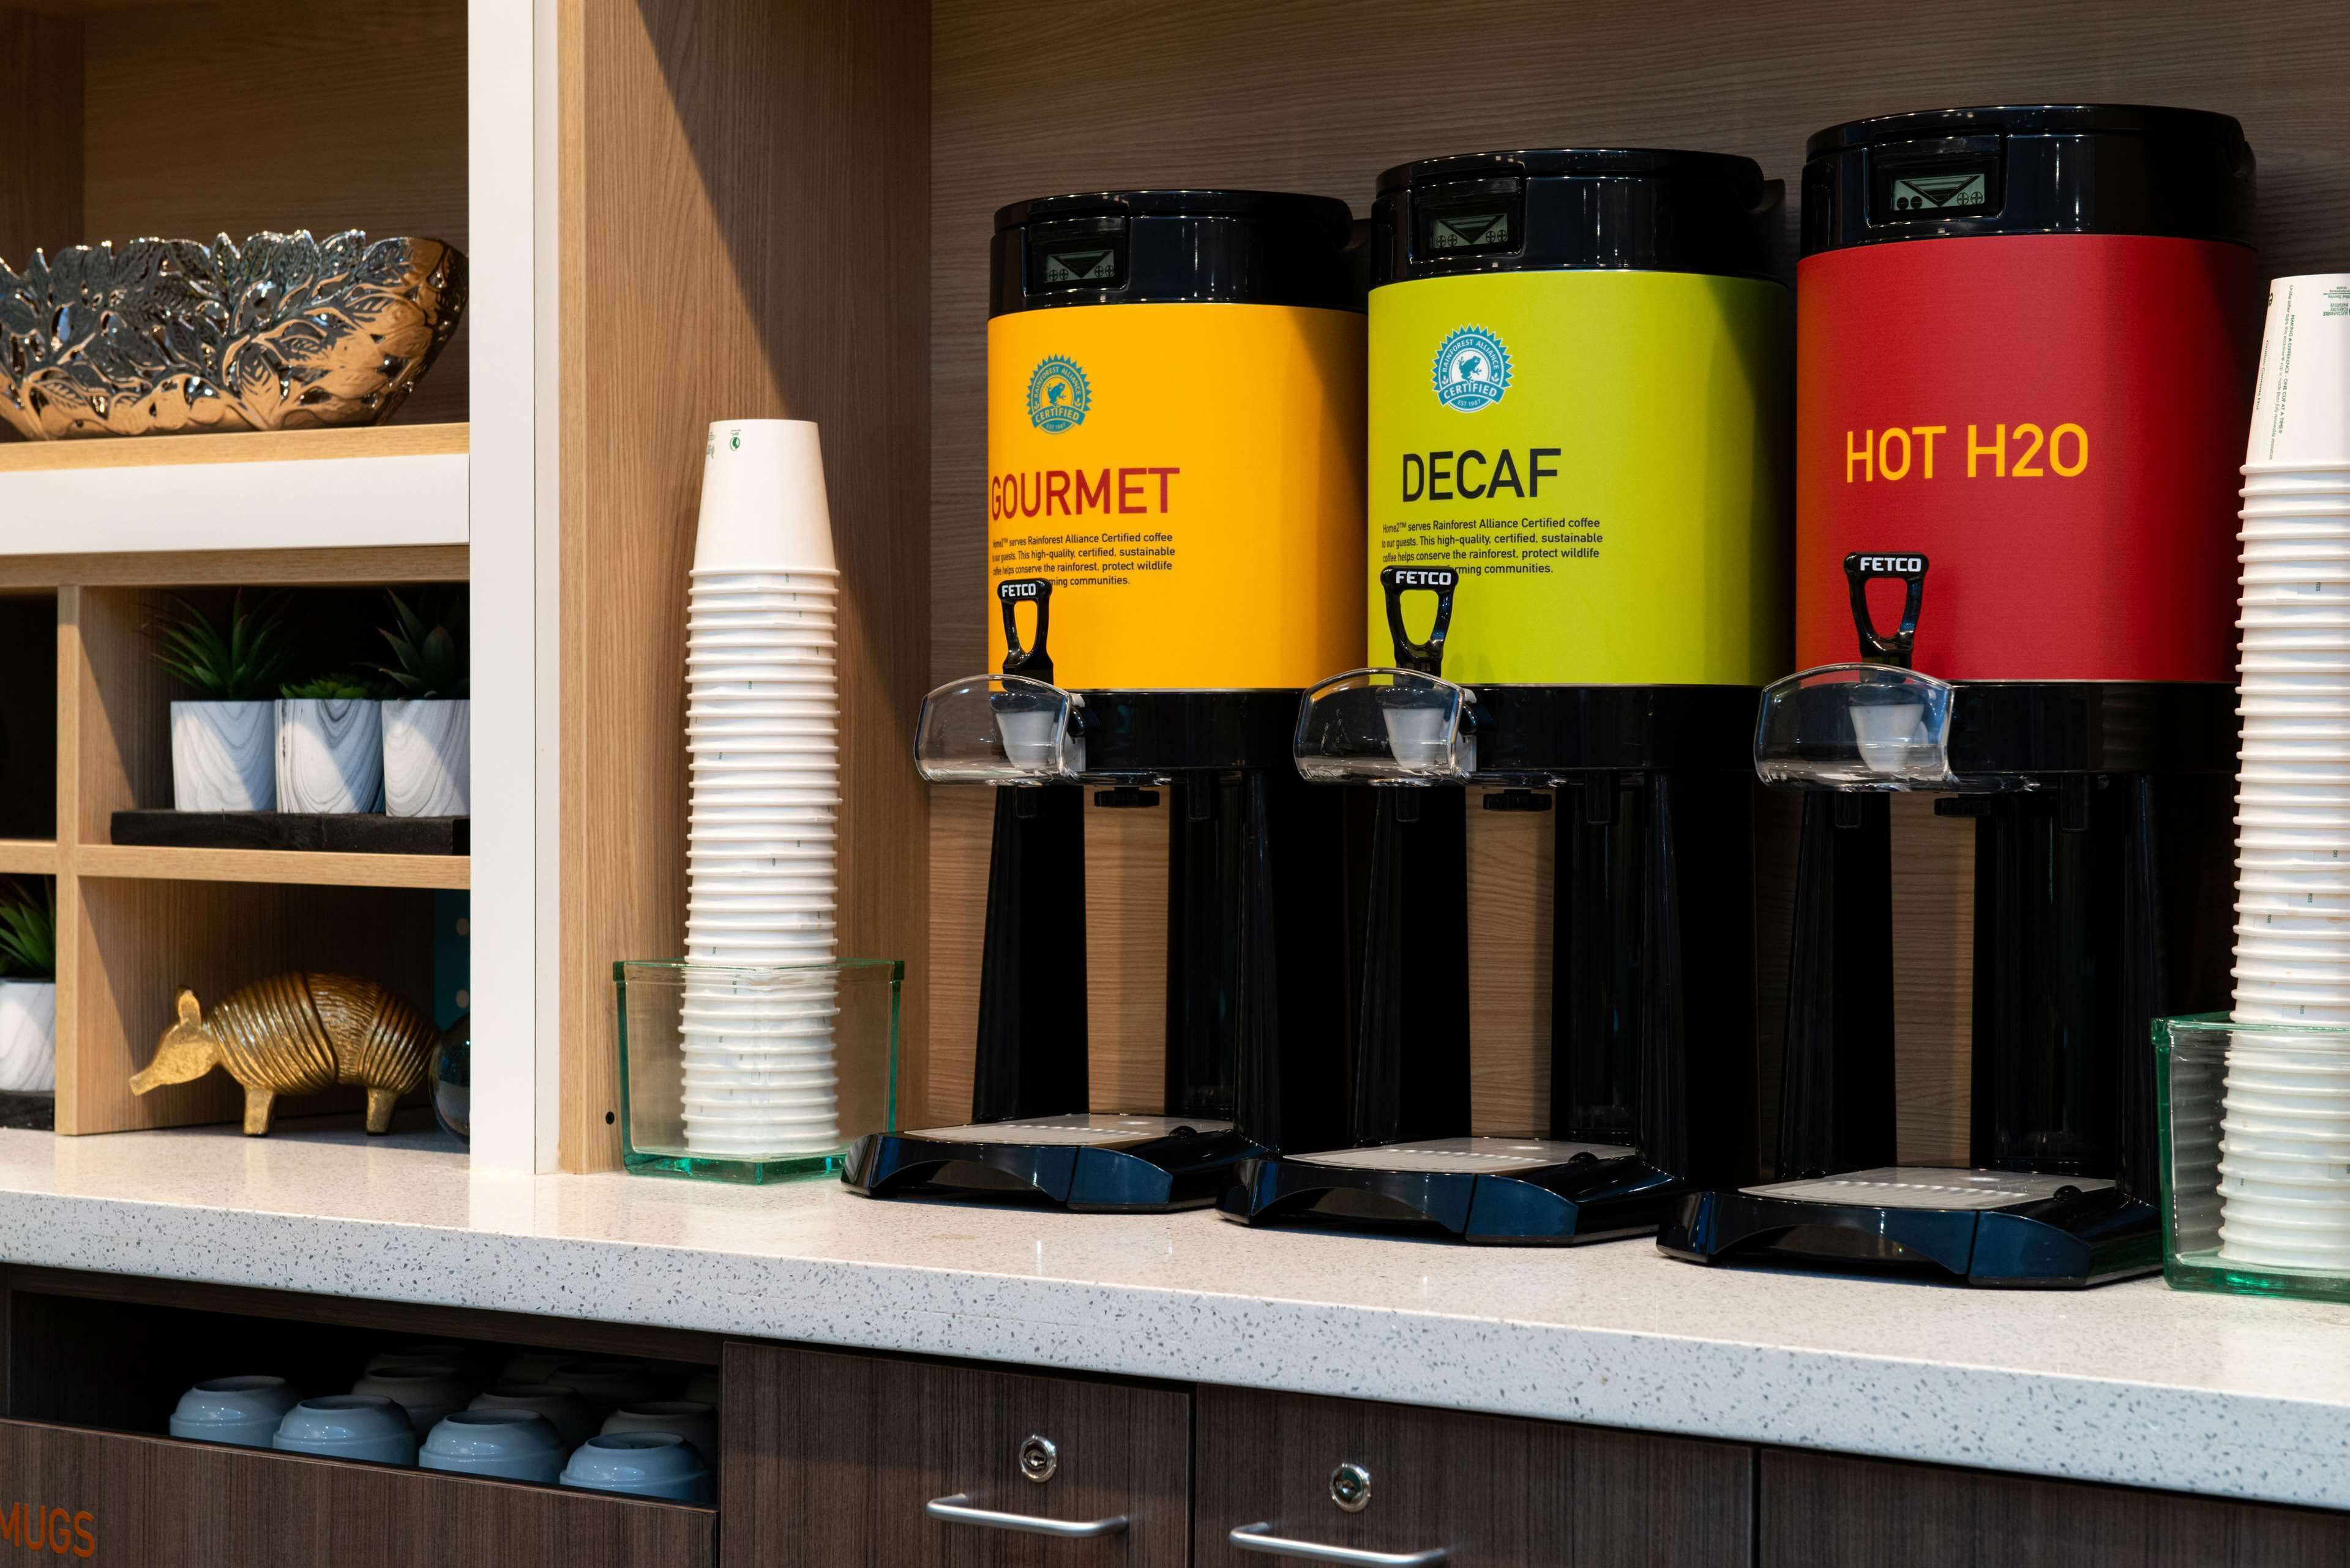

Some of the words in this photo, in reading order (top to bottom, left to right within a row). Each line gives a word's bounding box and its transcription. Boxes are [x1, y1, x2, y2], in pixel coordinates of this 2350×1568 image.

[1442, 339, 1474, 373] RAINFOREST
[1475, 340, 1499, 370] ALLIANCE
[1035, 367, 1059, 398] RAINFOREST
[1061, 368, 1082, 395] ALLIANCE
[1443, 383, 1497, 399] CERTIFIED
[1036, 408, 1080, 423] CERTIFIED
[1847, 425, 1947, 483] HOT
[1402, 448, 1562, 502] DECAF
[992, 467, 1180, 521] GOURMET
[1408, 523, 1431, 532] serves
[1433, 520, 1476, 530] Rainforest
[1479, 518, 1519, 528] Alliance
[1521, 518, 1565, 528] Certified
[1568, 518, 1600, 528] coffee
[1028, 534, 1063, 545] Rainforest
[1065, 534, 1099, 543] Alliance
[1102, 532, 1141, 543] Certified
[1143, 532, 1173, 542] coffee
[1396, 537, 1418, 550] guests.
[1420, 536, 1435, 545] This
[1541, 532, 1603, 543] sustainable
[1018, 550, 1030, 559] This
[1119, 547, 1175, 556] sustainable
[1383, 553, 1397, 563] coffee
[1398, 551, 1415, 563] helps
[1416, 551, 1451, 561] conserve
[1453, 549, 1467, 559] the
[1522, 549, 1559, 561] protect
[1561, 548, 1600, 558] wildlife
[1002, 565, 1014, 577] helps
[1015, 565, 1042, 573] conserve
[1044, 563, 1055, 572] the
[1102, 561, 1134, 573] protect
[1137, 561, 1173, 570] wildlife
[1484, 563, 1553, 573] communities.
[1860, 556, 1922, 572] FETCO
[1070, 576, 1131, 586] communities.
[1396, 570, 1452, 586] FETCO
[1001, 583, 1037, 597] FETCO
[0, 1501, 96, 1558] MUGS
